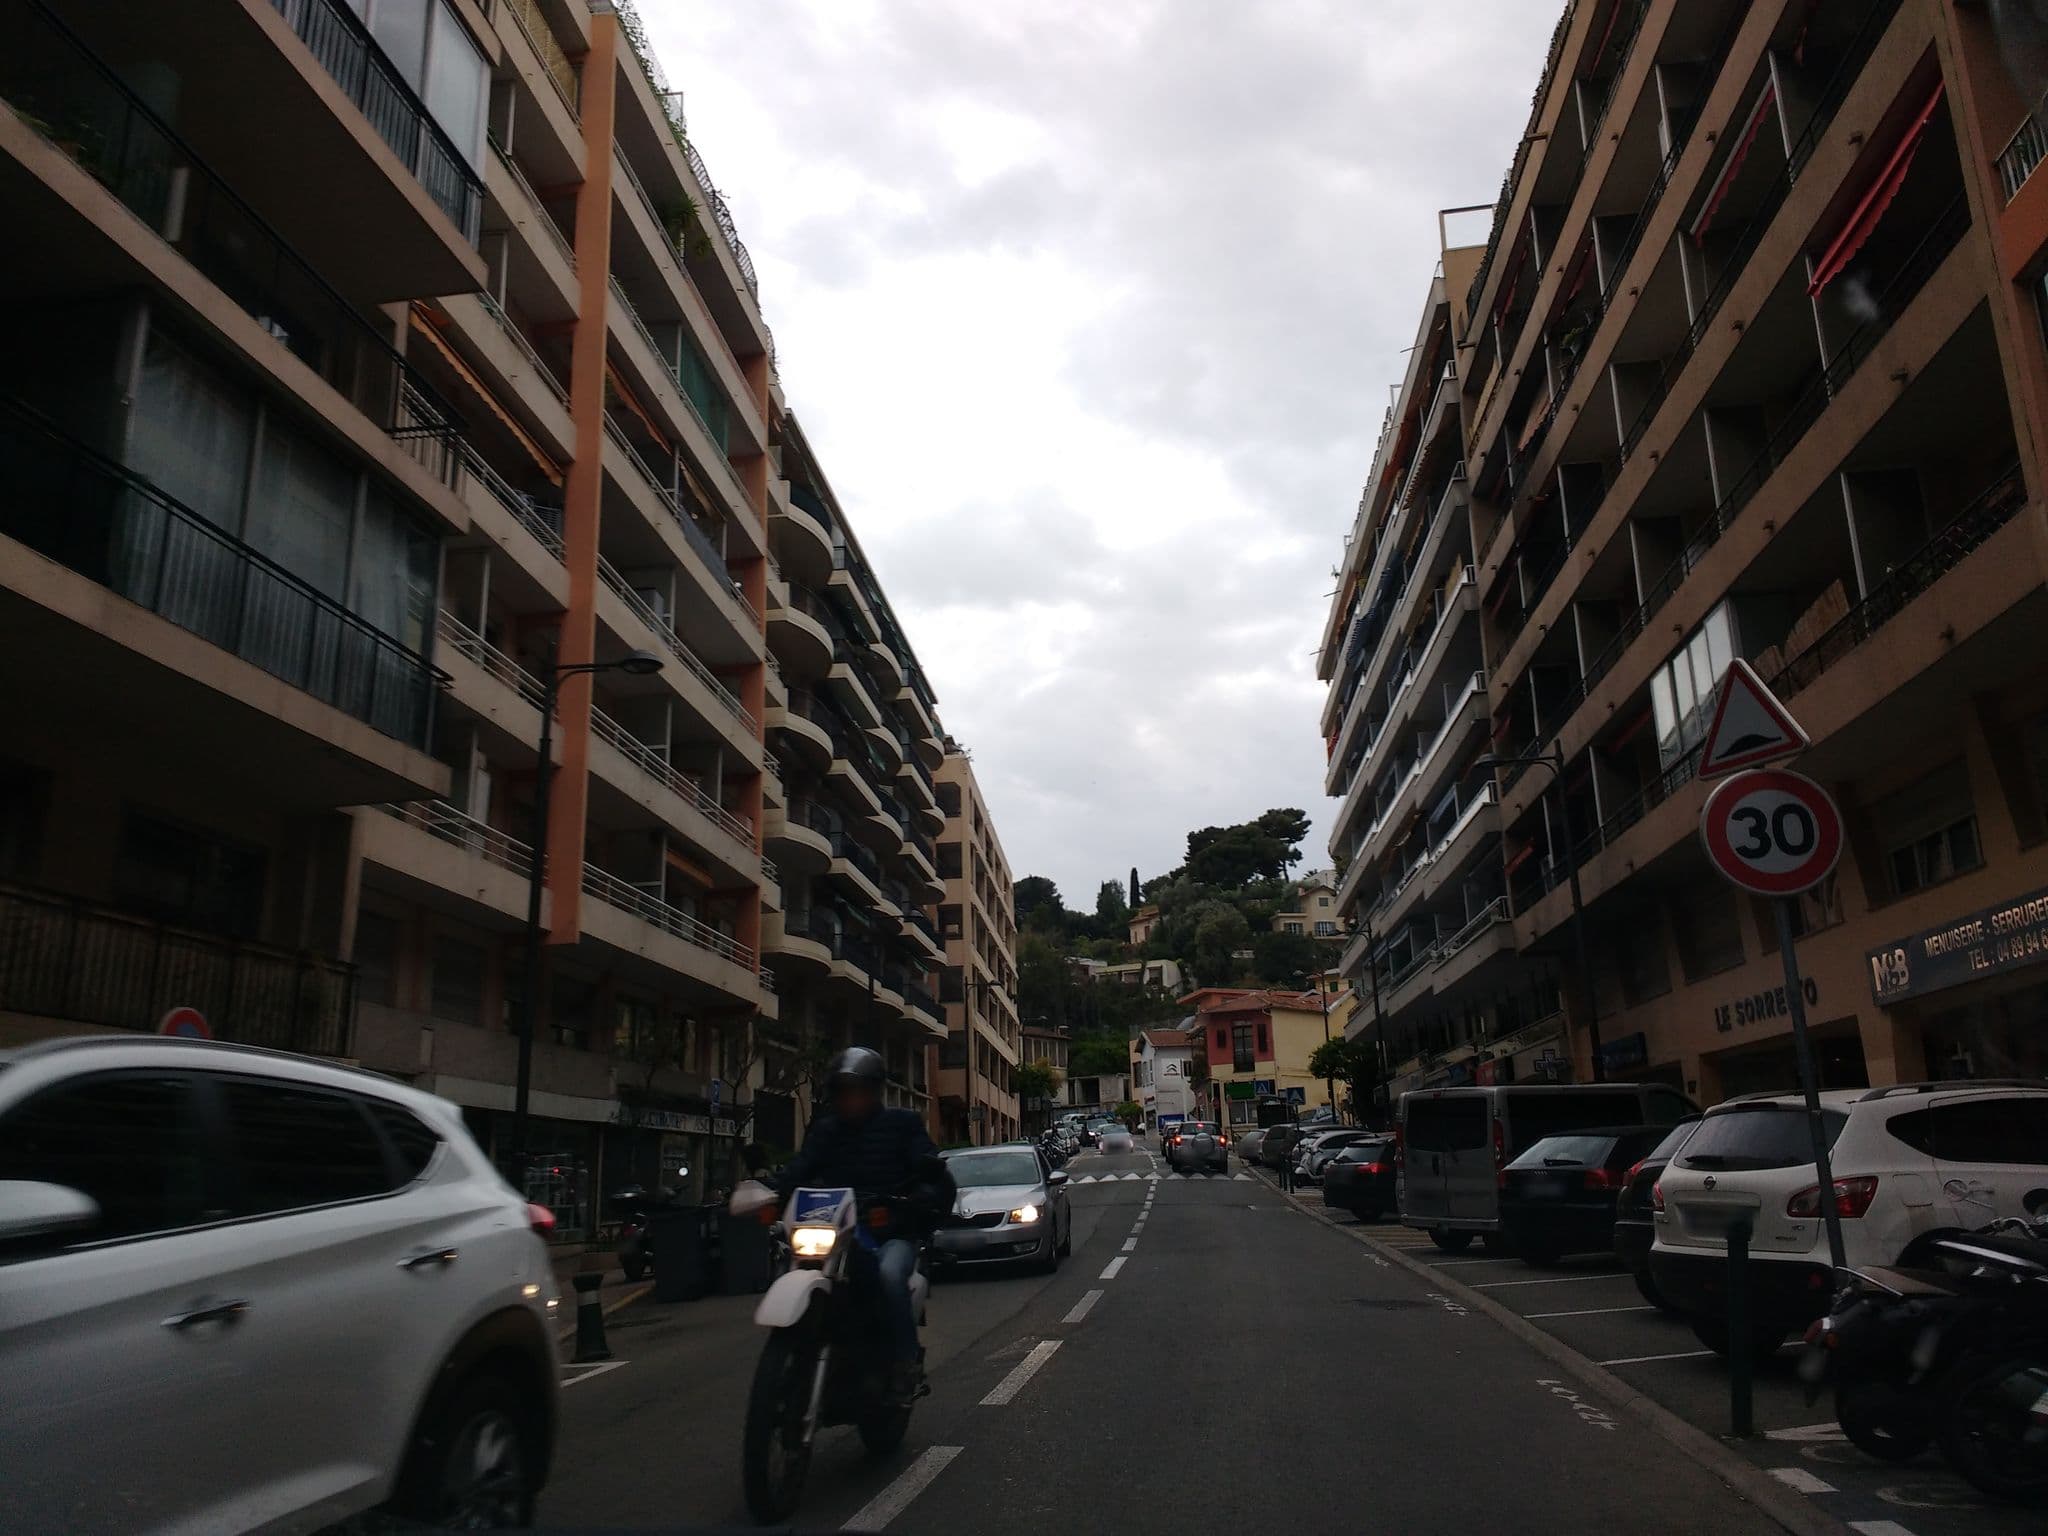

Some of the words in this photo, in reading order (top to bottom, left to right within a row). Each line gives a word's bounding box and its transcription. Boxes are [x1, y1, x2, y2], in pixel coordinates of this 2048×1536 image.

[1731, 803, 1815, 859] 30
[1924, 920, 1985, 958] MENUISERIE
[1714, 1004, 1732, 1033] LE
[1735, 977, 1818, 1027] SORREO
